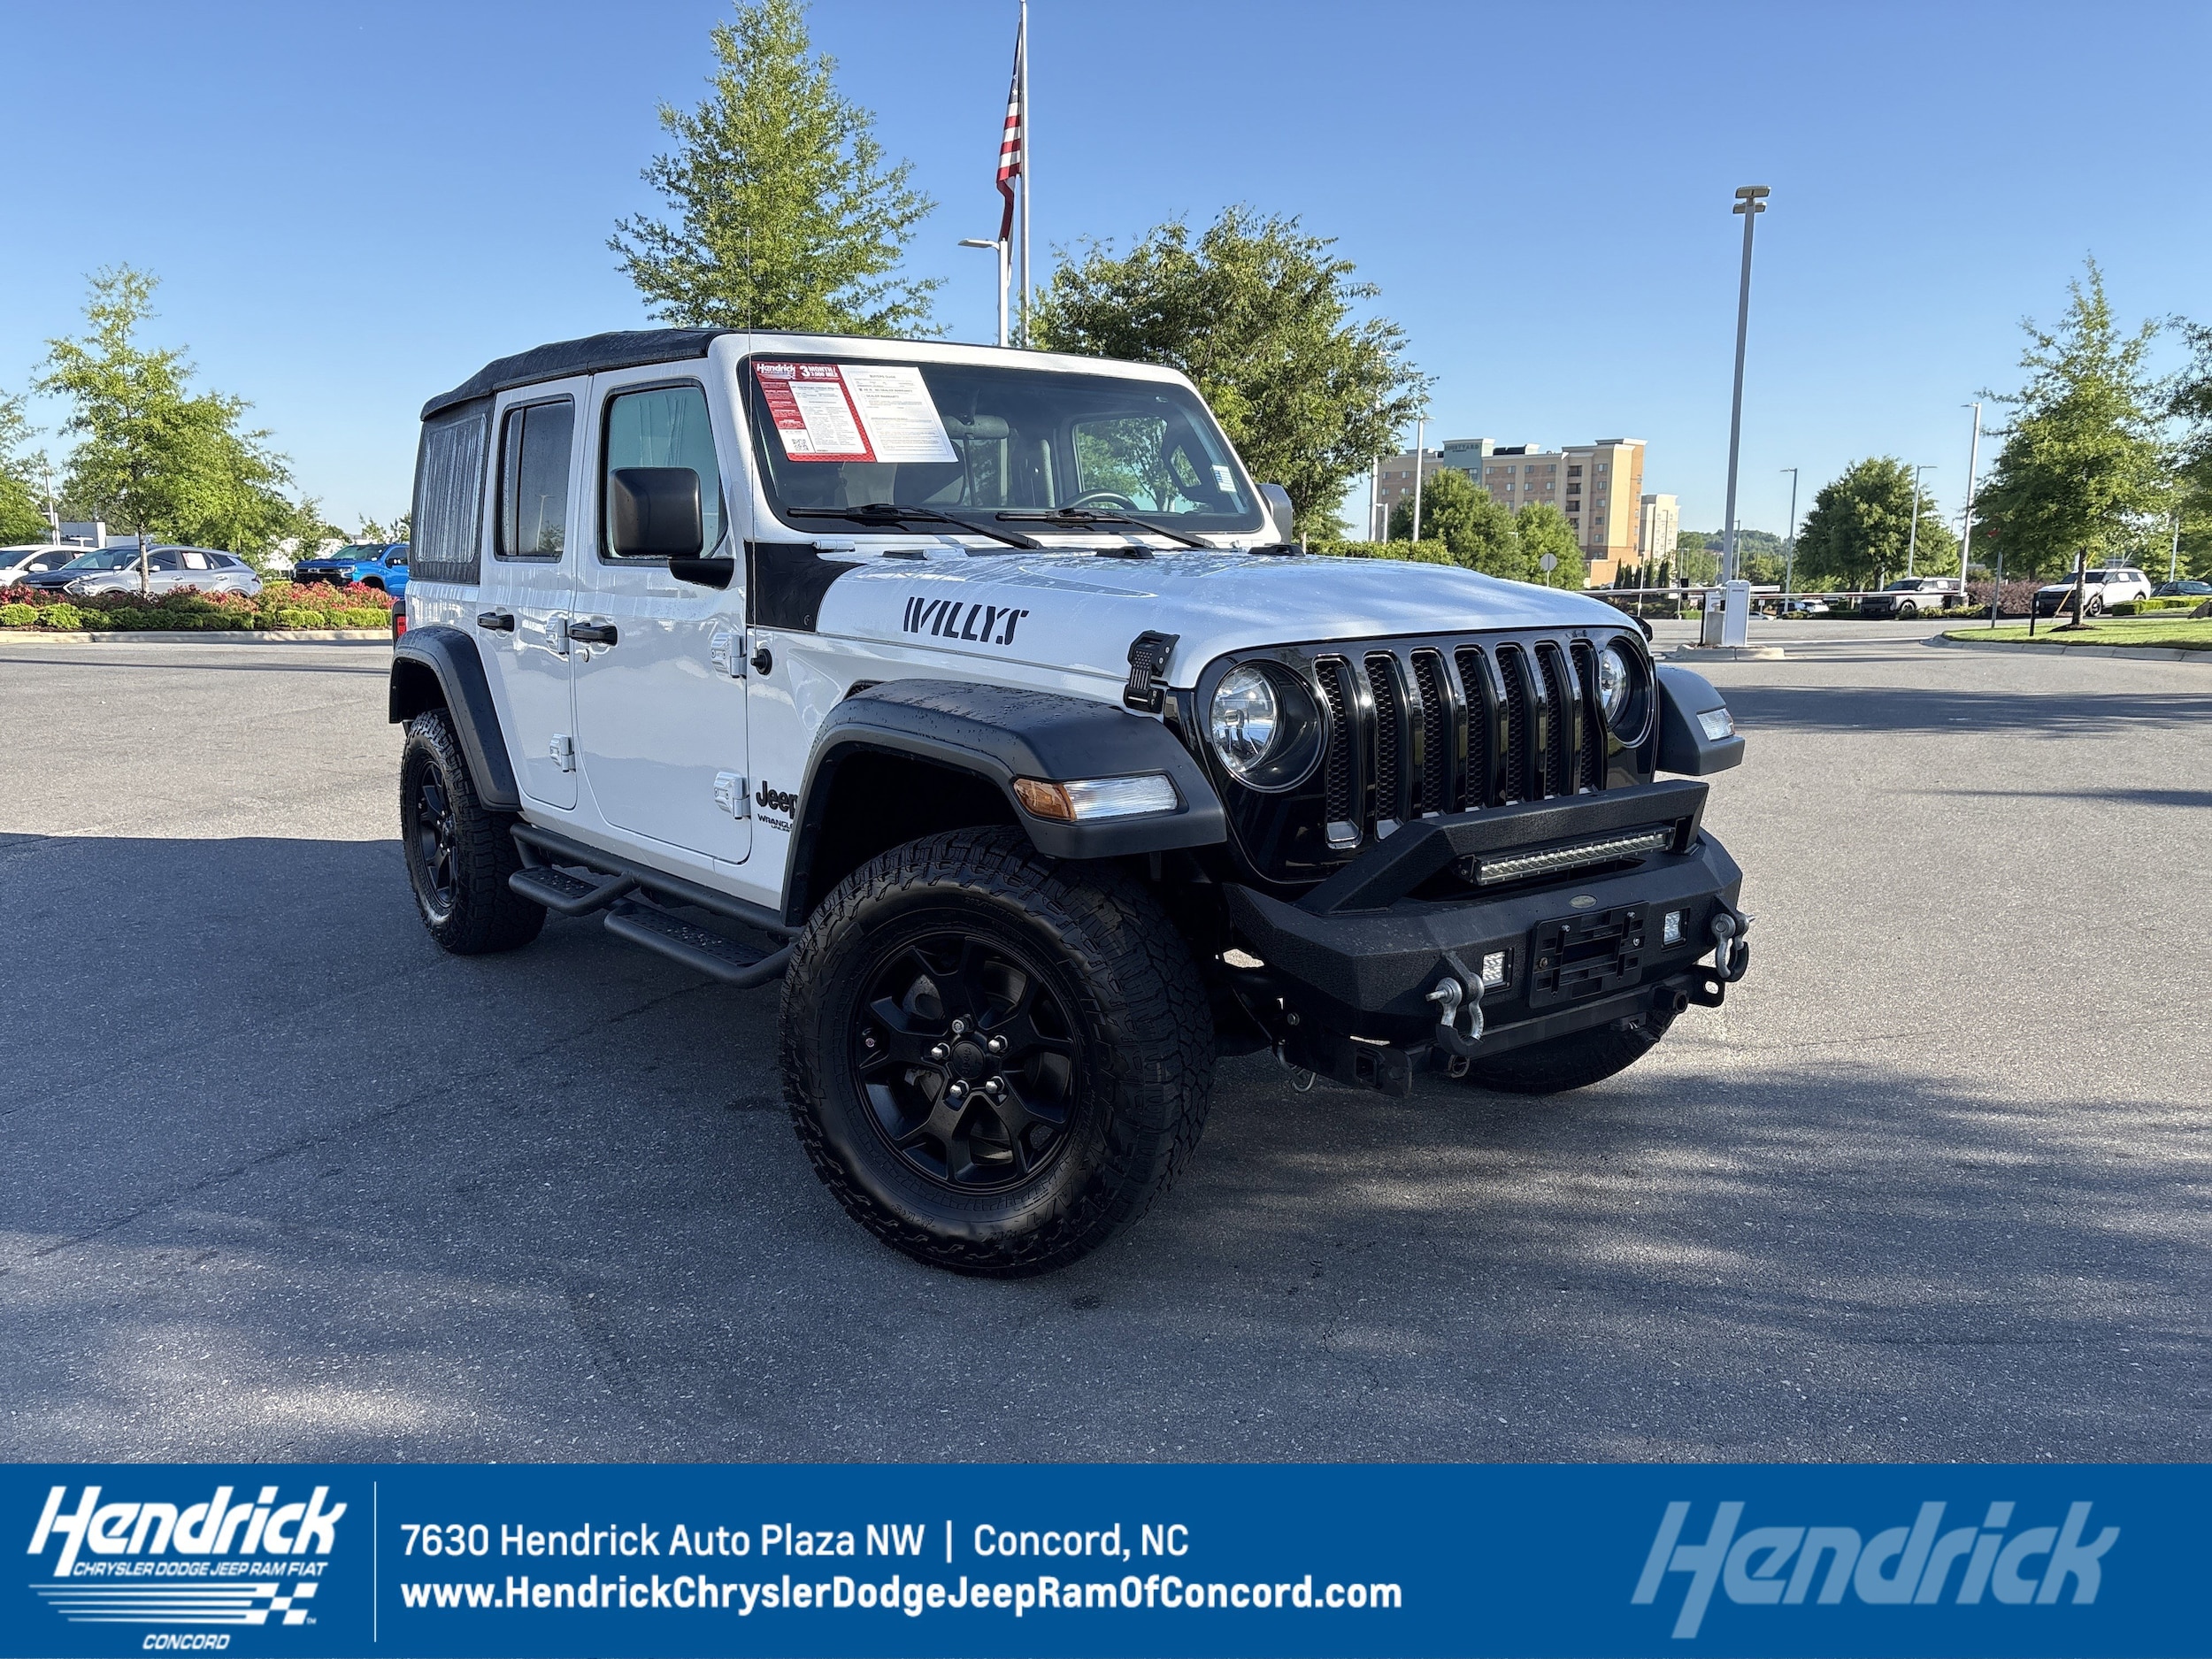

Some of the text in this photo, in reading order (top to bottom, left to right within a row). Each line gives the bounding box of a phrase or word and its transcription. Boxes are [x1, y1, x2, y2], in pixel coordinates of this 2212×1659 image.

[757, 364, 795, 373] Hendrick
[800, 365, 811, 377] 3
[903, 596, 1030, 646] WILLYS
[756, 780, 799, 819] Jeep
